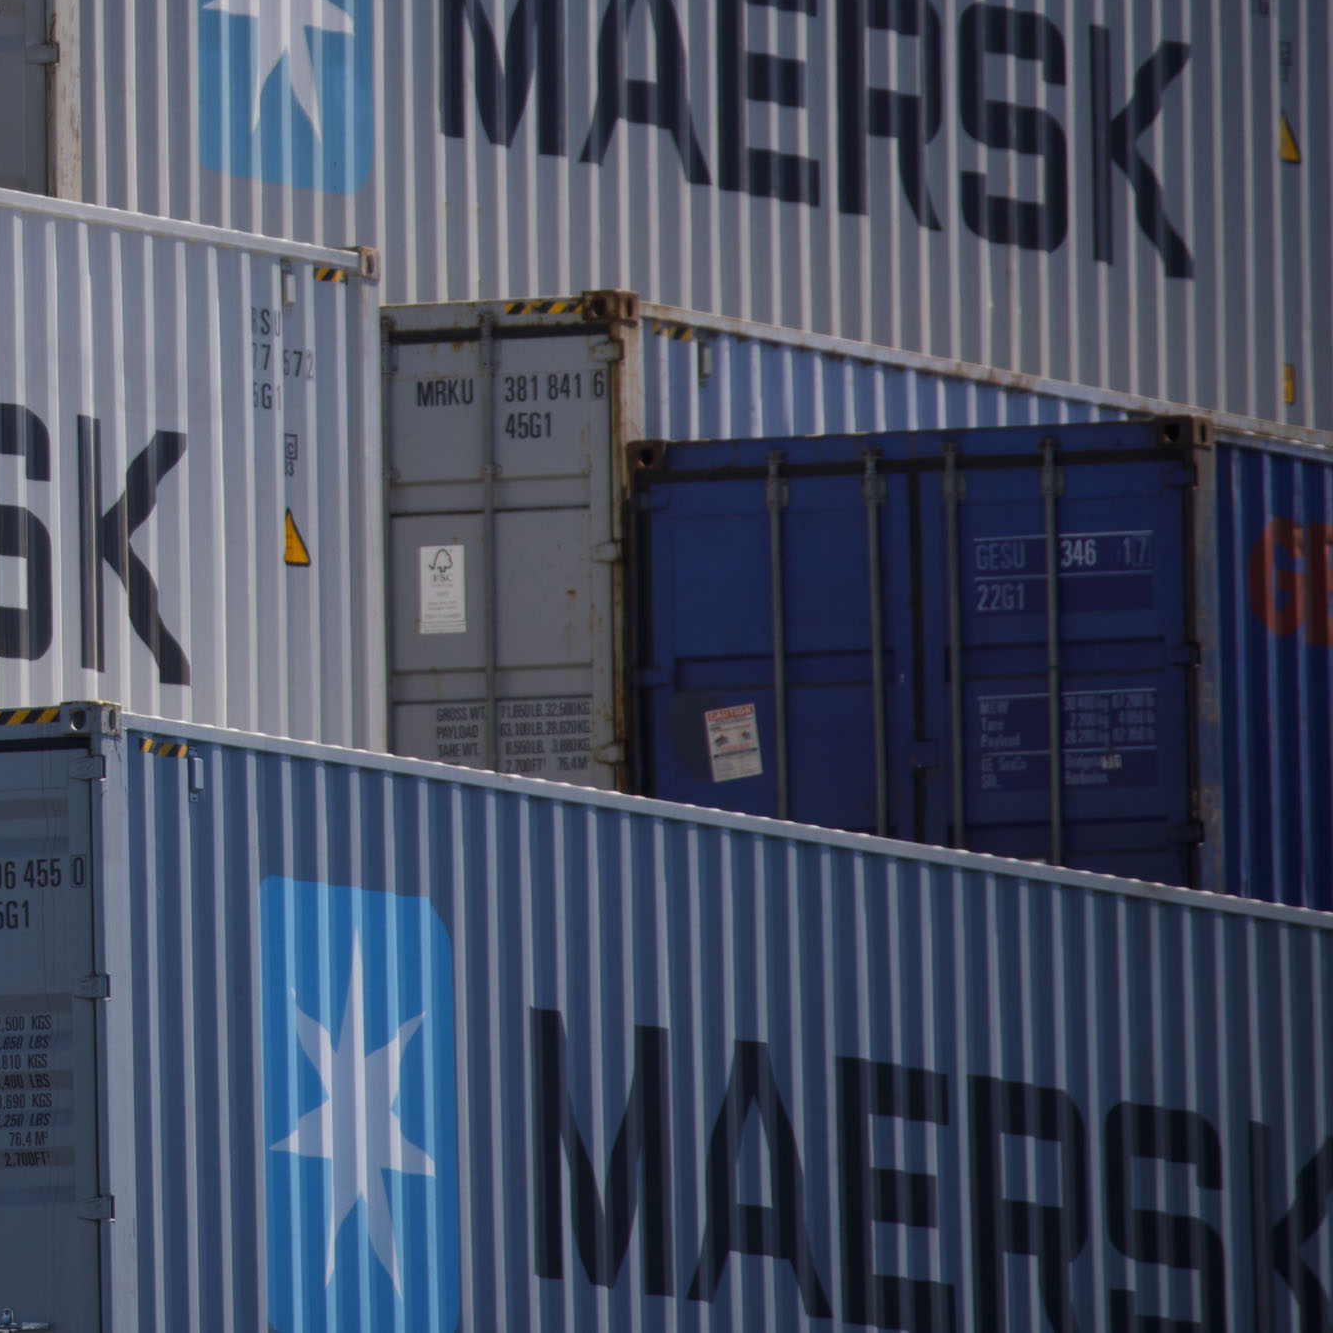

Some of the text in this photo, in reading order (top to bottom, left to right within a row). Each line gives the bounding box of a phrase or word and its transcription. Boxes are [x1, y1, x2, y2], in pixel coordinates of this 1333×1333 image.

[416, 372, 604, 408] MRKU 381 841 6
[504, 411, 552, 439] 45G1
[975, 542, 1026, 571] GESU
[1060, 538, 1097, 568] 346
[976, 582, 1024, 612] 22G1
[436, 707, 468, 722] GROSS
[436, 724, 479, 739] PAYLOAD
[438, 743, 461, 758] TARE
[24, 858, 62, 888] 455
[31, 1014, 52, 1031] KGS
[29, 1035, 50, 1049] LBS
[28, 1053, 47, 1069] KGS
[30, 1074, 51, 1088] LBS
[32, 1093, 52, 1108] KGS
[29, 1112, 51, 1127] LBS
[9, 1131, 31, 1146] 76.4
[531, 1006, 1333, 1333] MAERSK
